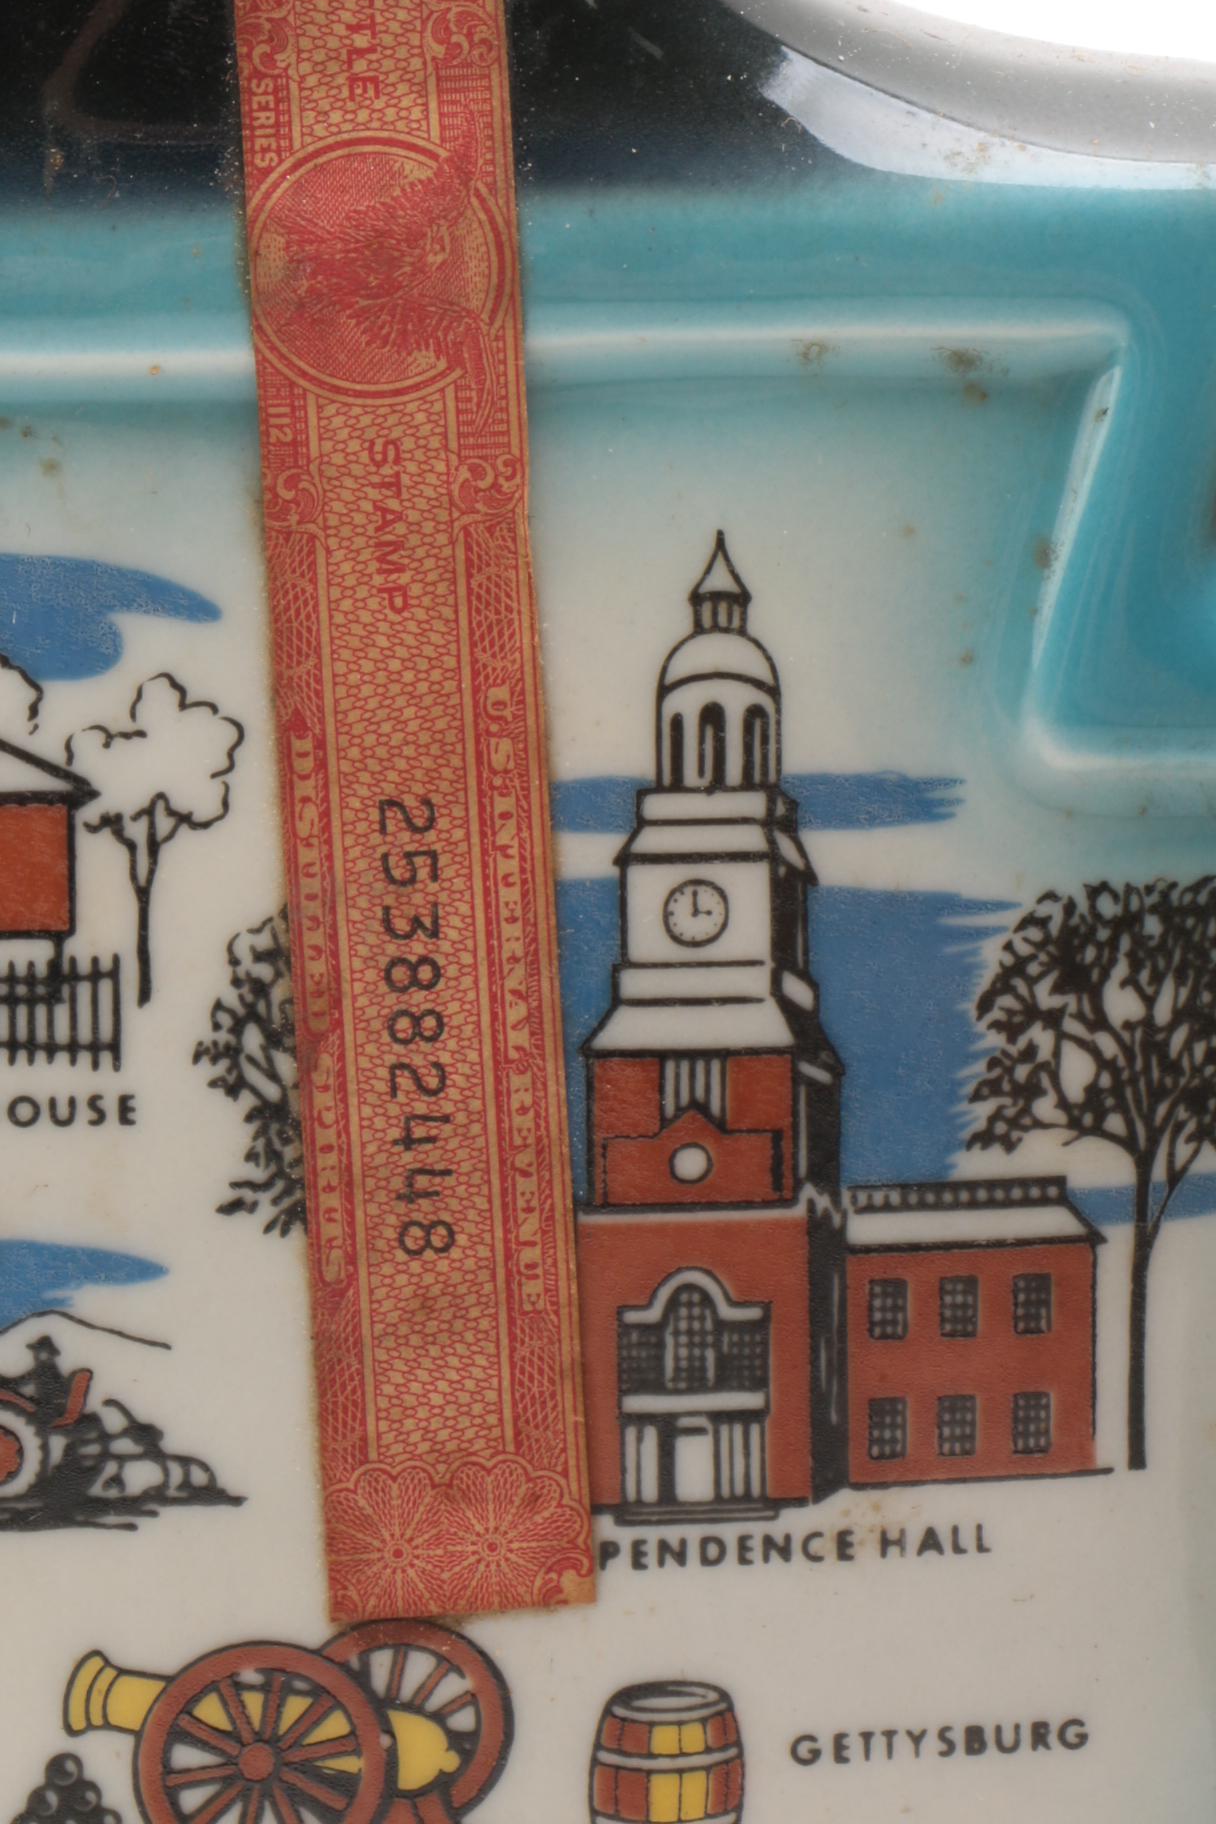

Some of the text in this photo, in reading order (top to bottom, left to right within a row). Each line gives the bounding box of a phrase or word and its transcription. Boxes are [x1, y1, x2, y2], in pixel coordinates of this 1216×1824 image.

[250, 78, 280, 170] SERIES
[367, 438, 410, 615] STAMP
[492, 788, 530, 1064] INTERNAL
[6, 1093, 138, 1129] OUSE
[377, 796, 457, 1258] 253882448
[312, 1051, 344, 1283] SPIRITS
[508, 1067, 546, 1312] REVENUE
[598, 1522, 993, 1572] PENDENCE HALL
[790, 1717, 1090, 1767] GETTYSBURG
